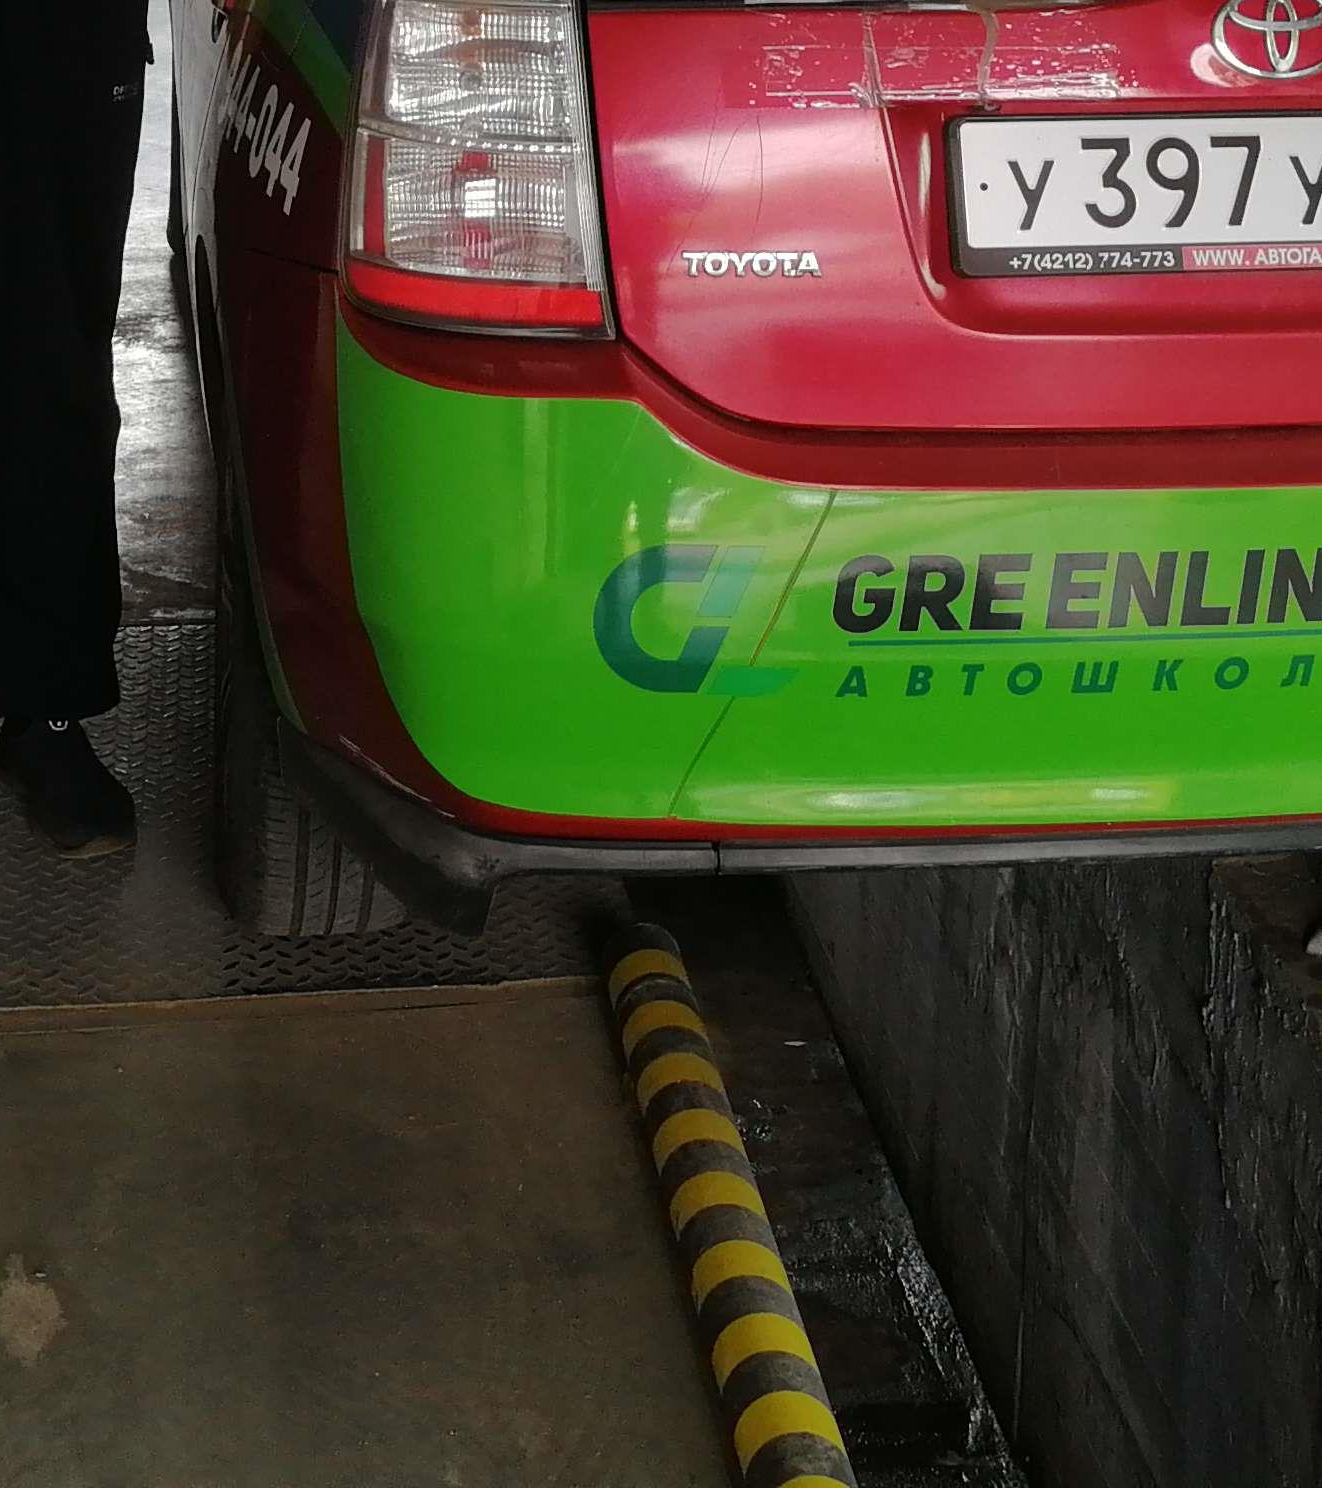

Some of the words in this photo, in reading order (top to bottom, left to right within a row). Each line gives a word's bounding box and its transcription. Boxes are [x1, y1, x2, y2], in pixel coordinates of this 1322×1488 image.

[682, 251, 822, 277] TOYOTA
[1008, 252, 1094, 270] +7(4212)
[1097, 250, 1176, 269] 774-773
